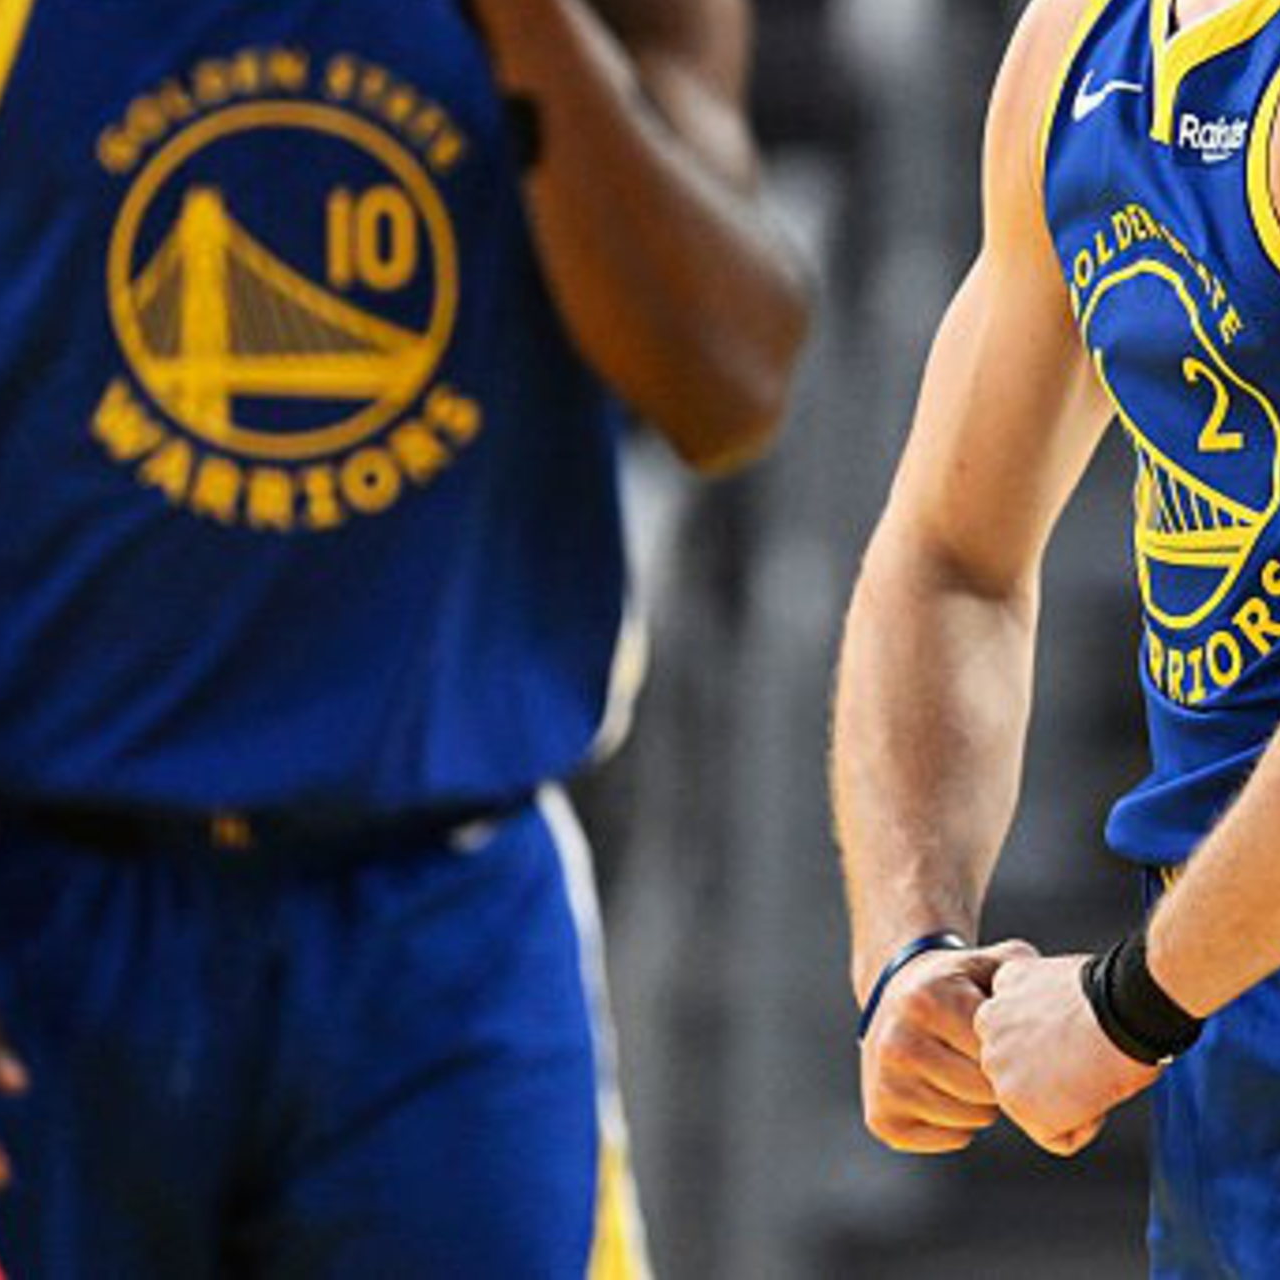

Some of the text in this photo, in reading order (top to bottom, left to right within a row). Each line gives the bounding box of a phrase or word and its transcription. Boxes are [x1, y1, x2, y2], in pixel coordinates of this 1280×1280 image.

[98, 48, 307, 172] GOLDEN
[328, 186, 417, 290] 10
[93, 378, 481, 531] WARRIORS
[1182, 356, 1244, 452] 2
